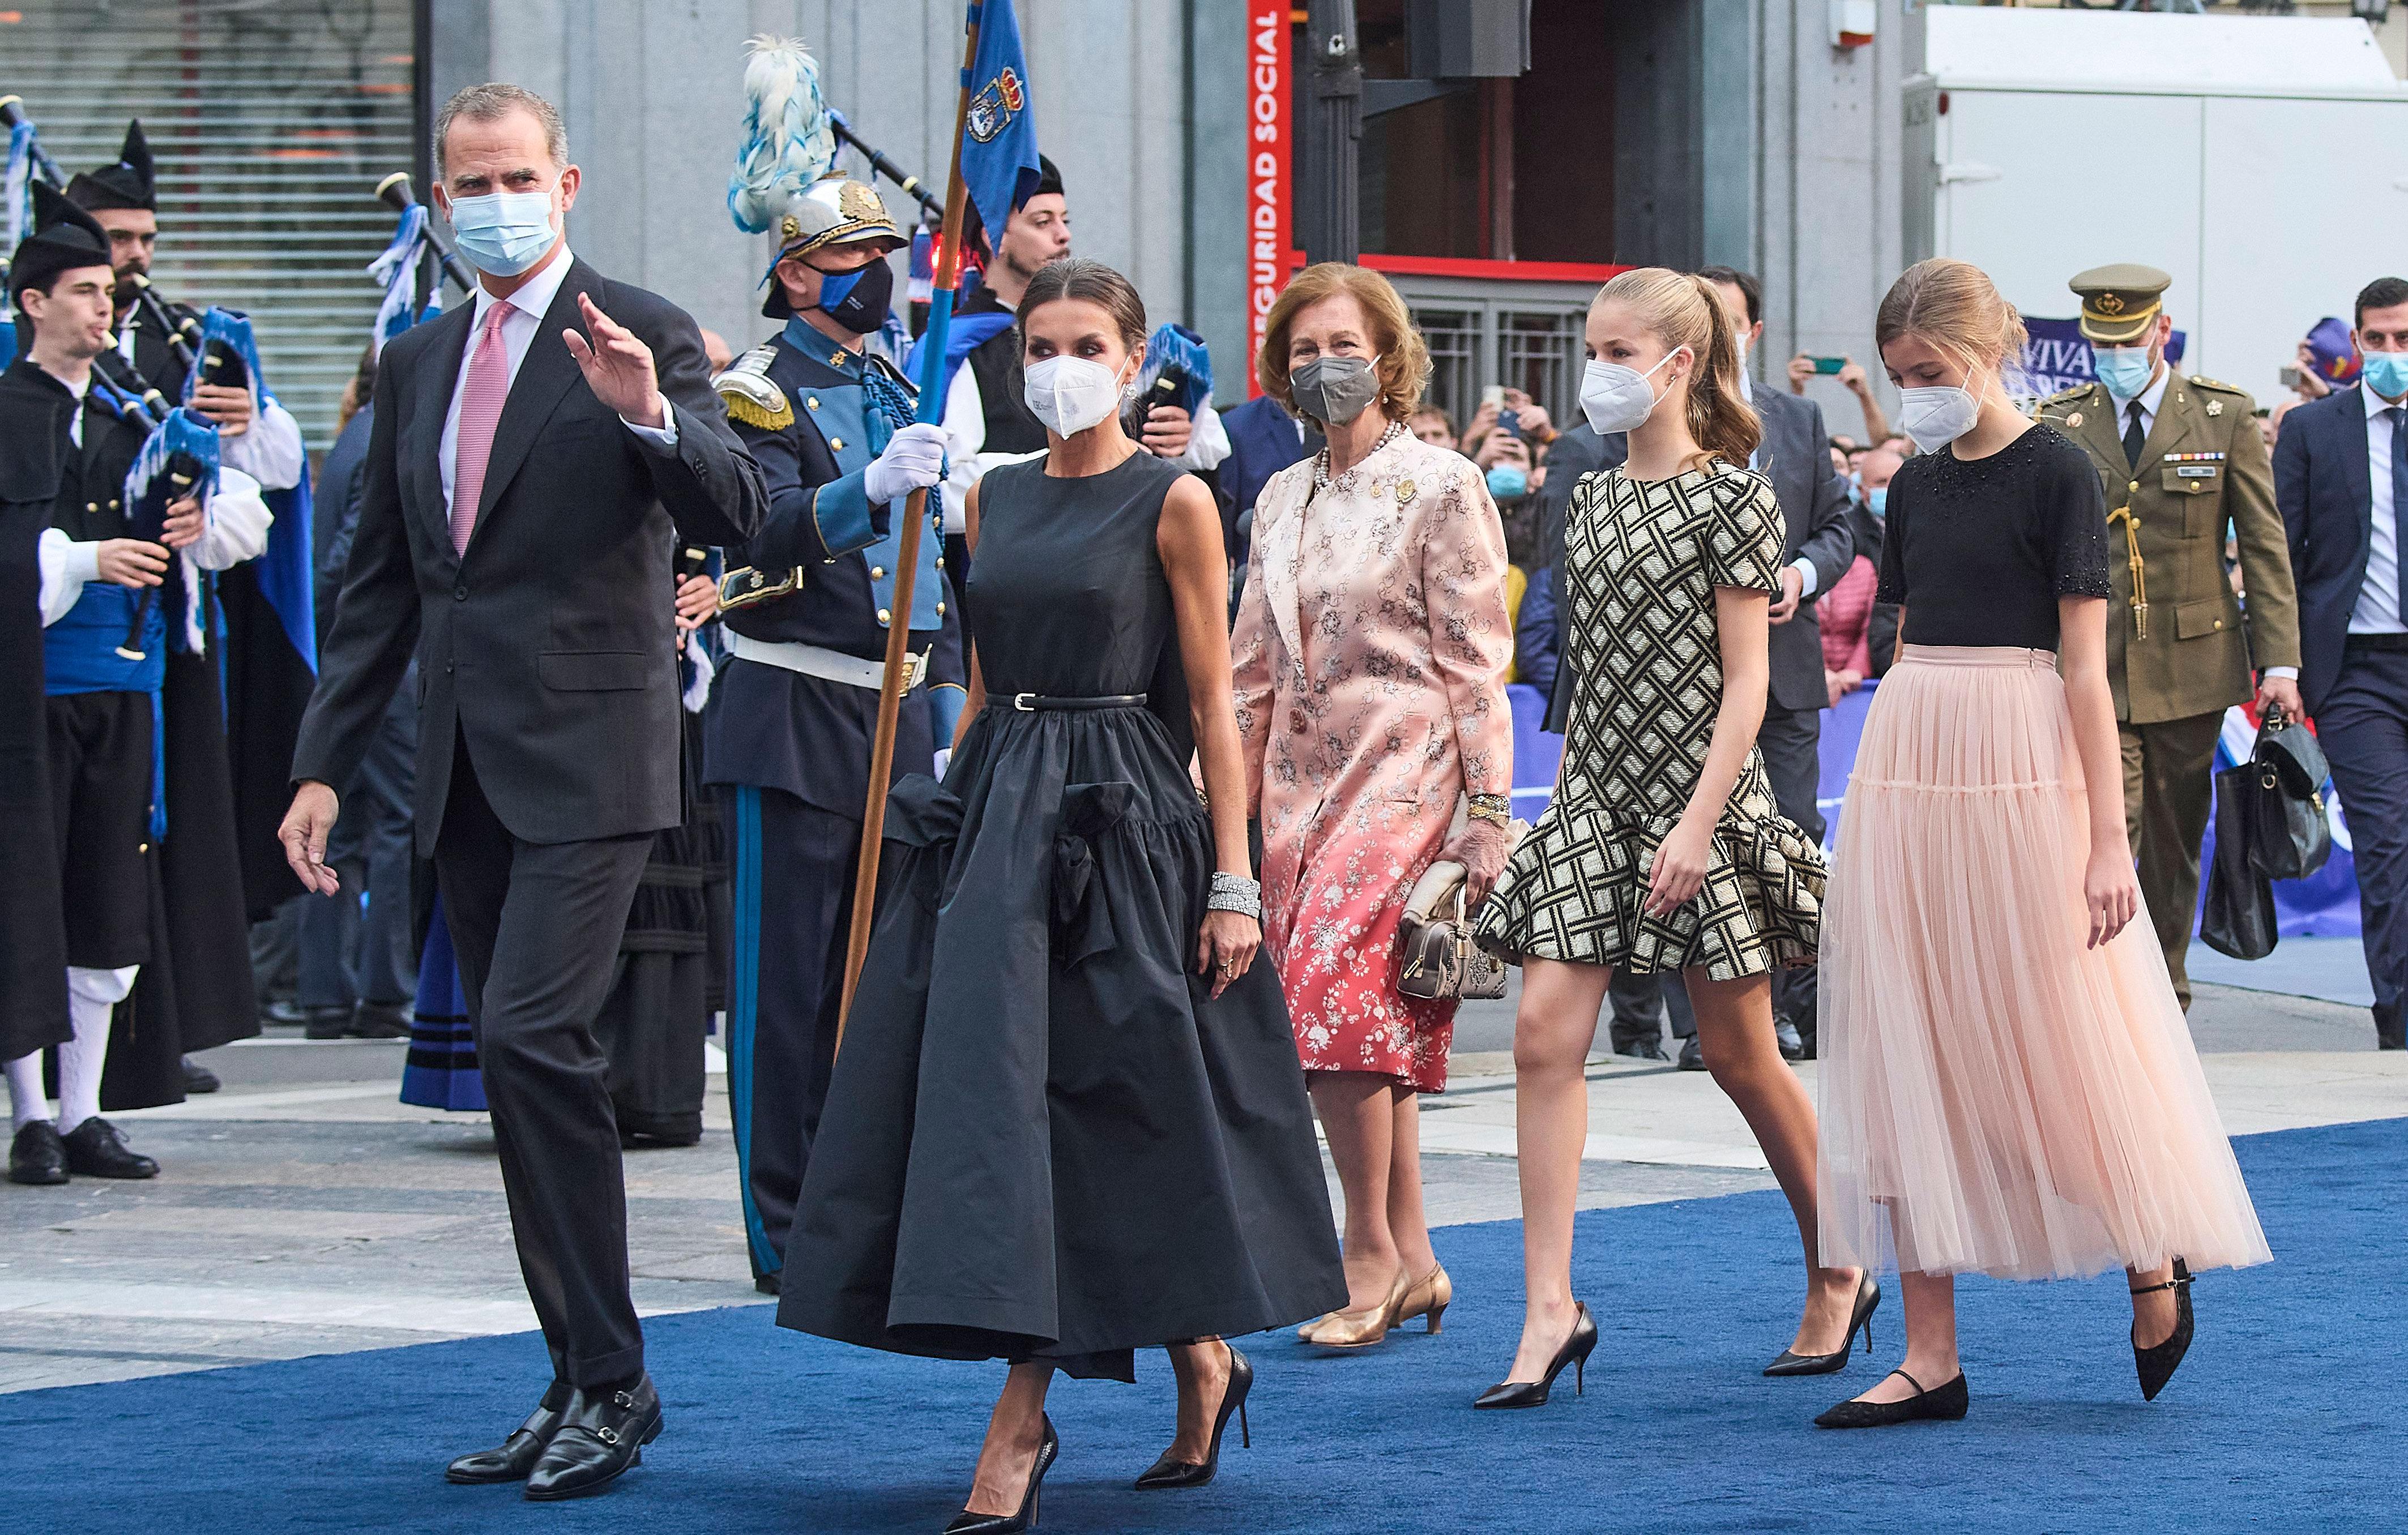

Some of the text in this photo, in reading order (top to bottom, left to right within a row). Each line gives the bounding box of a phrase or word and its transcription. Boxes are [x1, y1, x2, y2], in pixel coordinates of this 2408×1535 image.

[1254, 10, 1278, 143] SOCIAL
[2021, 338, 2092, 377] VIVA
[2035, 374, 2100, 397] RE
